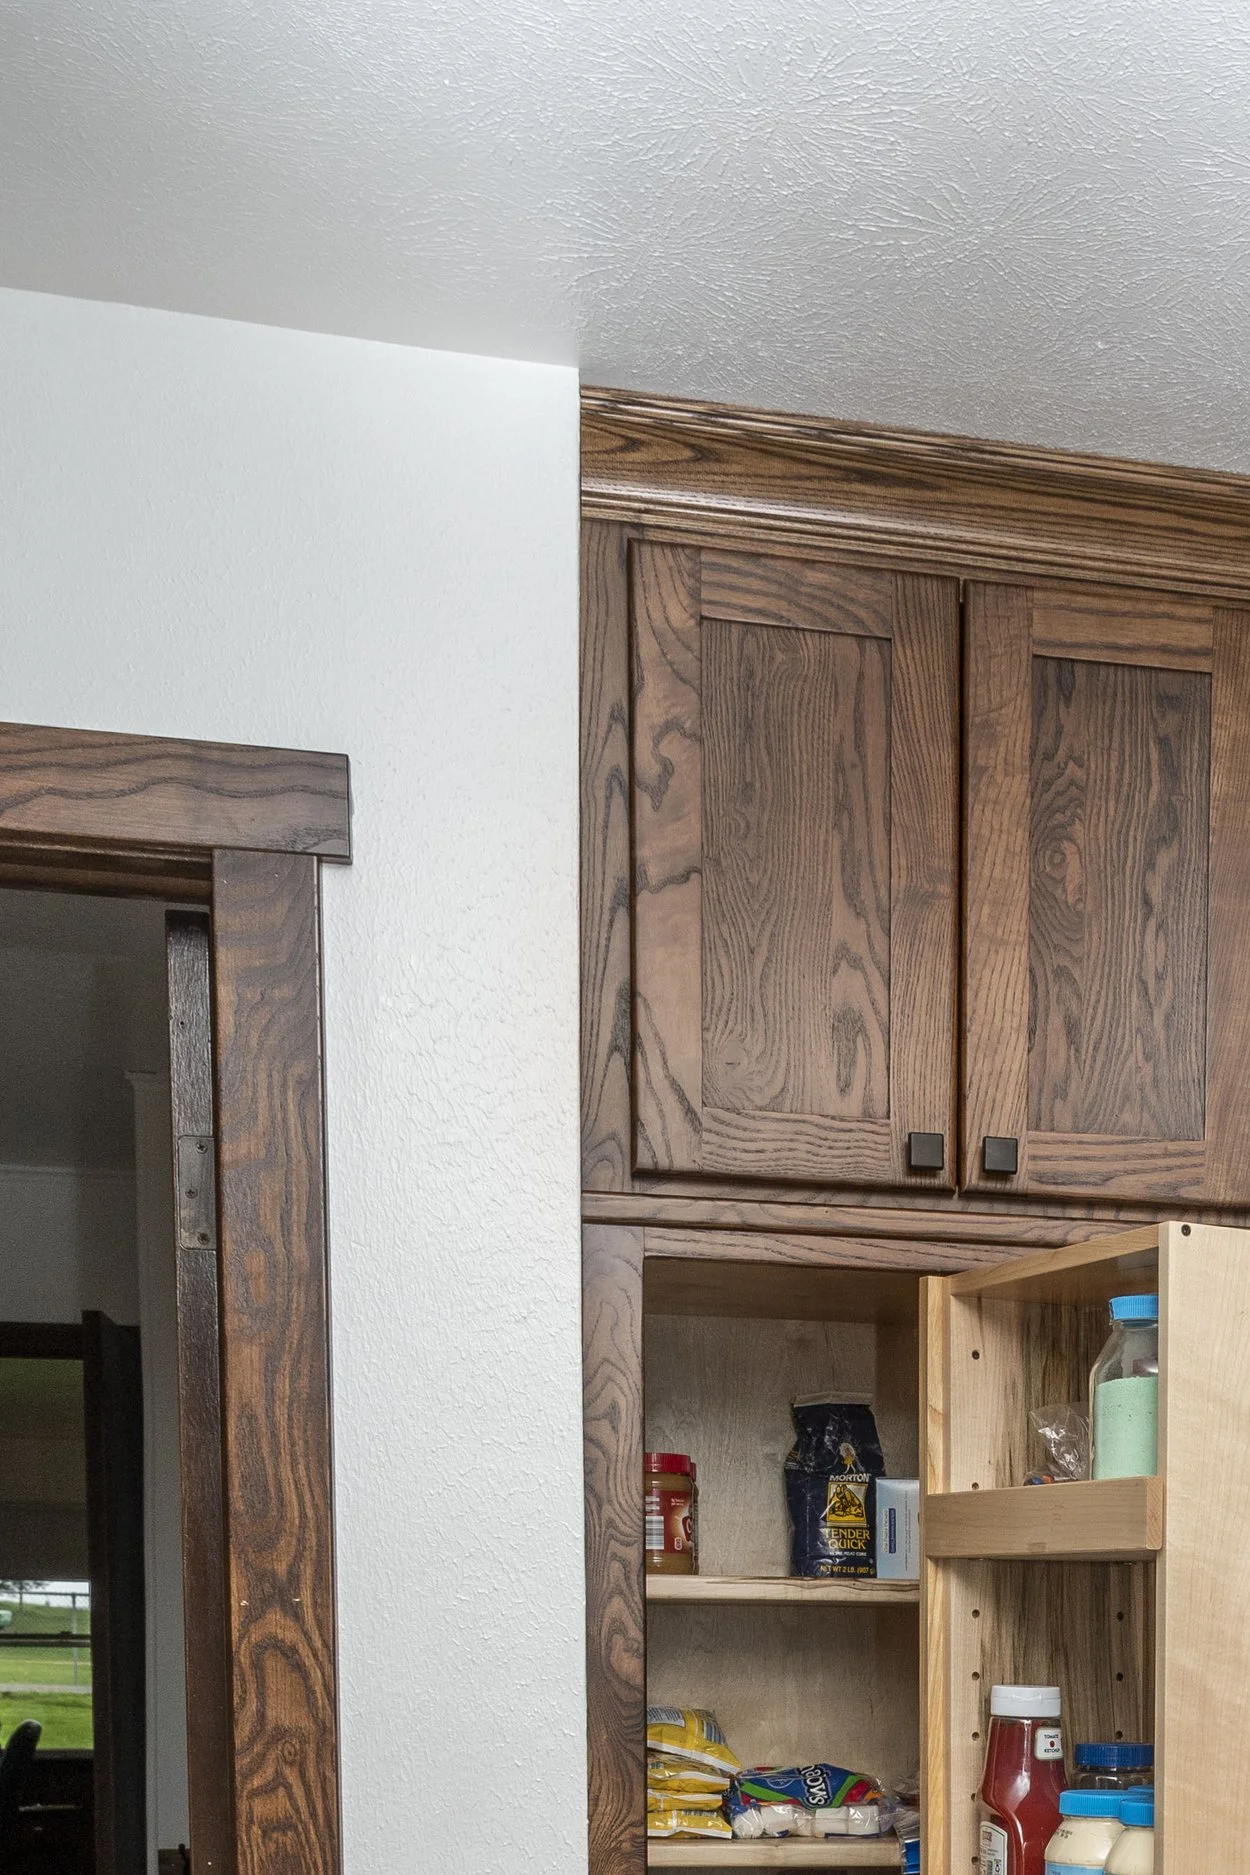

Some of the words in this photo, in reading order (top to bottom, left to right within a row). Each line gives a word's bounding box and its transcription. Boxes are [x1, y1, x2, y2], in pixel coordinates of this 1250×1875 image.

[830, 1474, 870, 1482] MORTON
[823, 1529, 870, 1540] TENDER
[828, 1539, 866, 1550] QUICK
